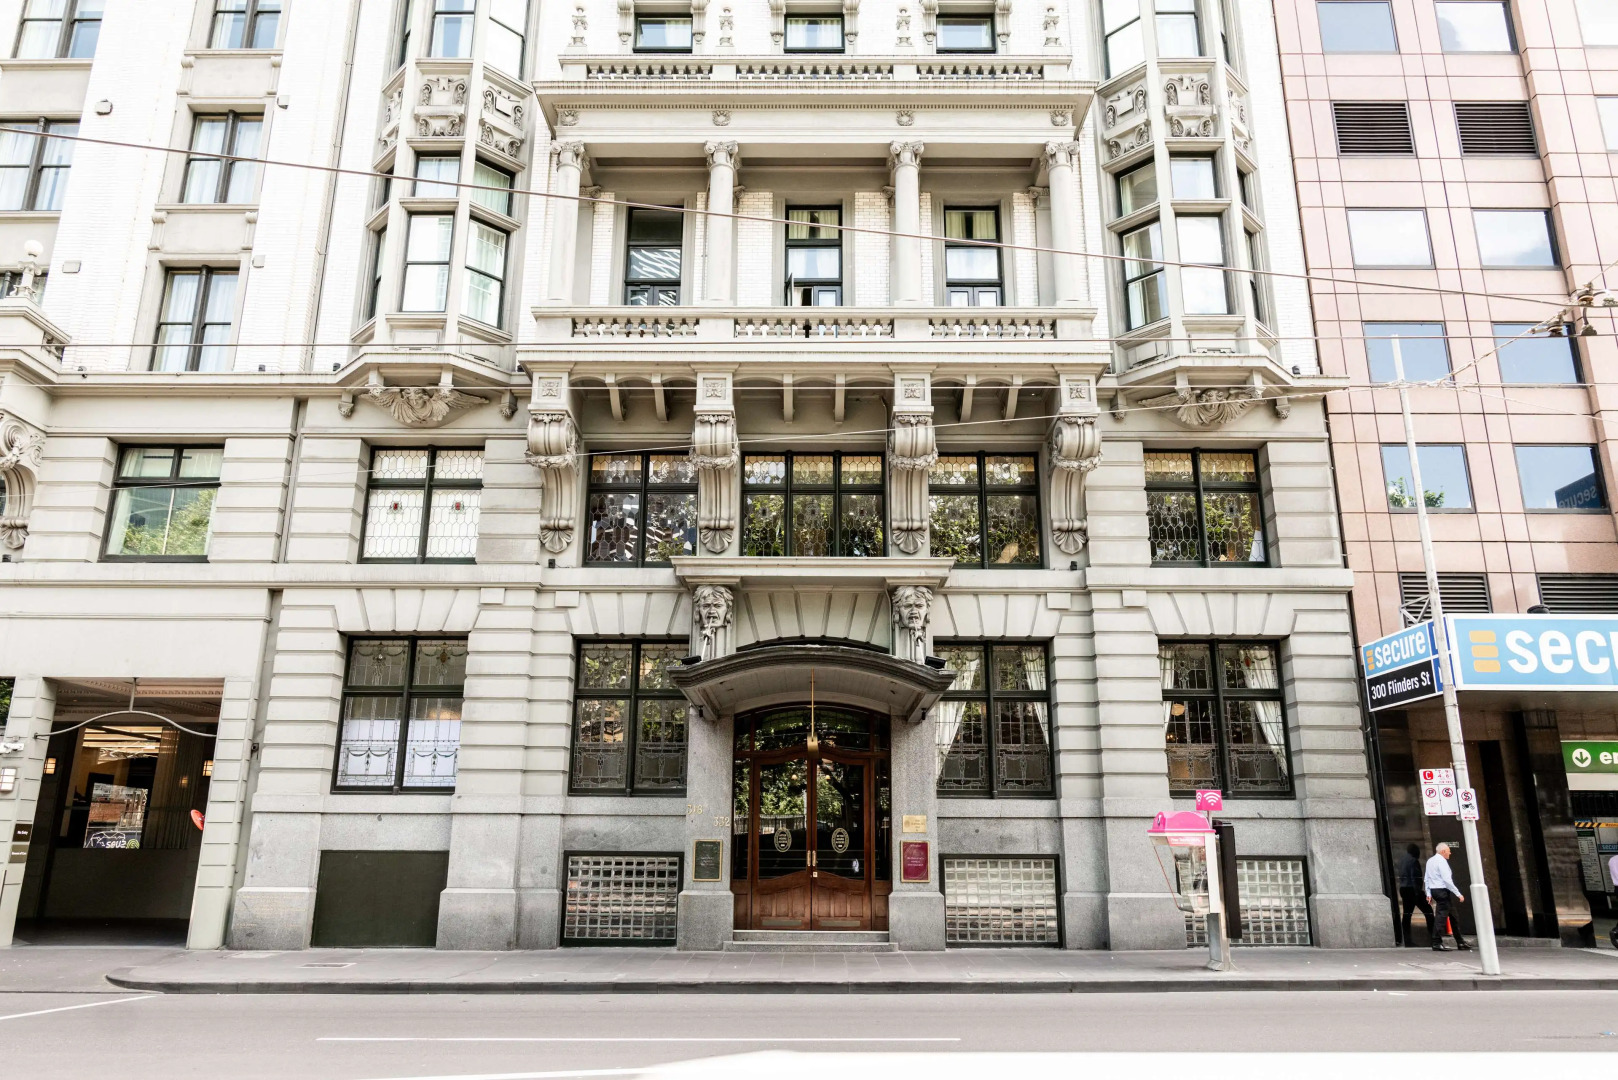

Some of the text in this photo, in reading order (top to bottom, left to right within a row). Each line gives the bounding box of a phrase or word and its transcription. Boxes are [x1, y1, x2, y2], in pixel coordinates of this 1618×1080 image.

[1374, 631, 1426, 668] secure
[1505, 629, 1618, 674] sec
[1371, 671, 1431, 700] 300 Flinders St
